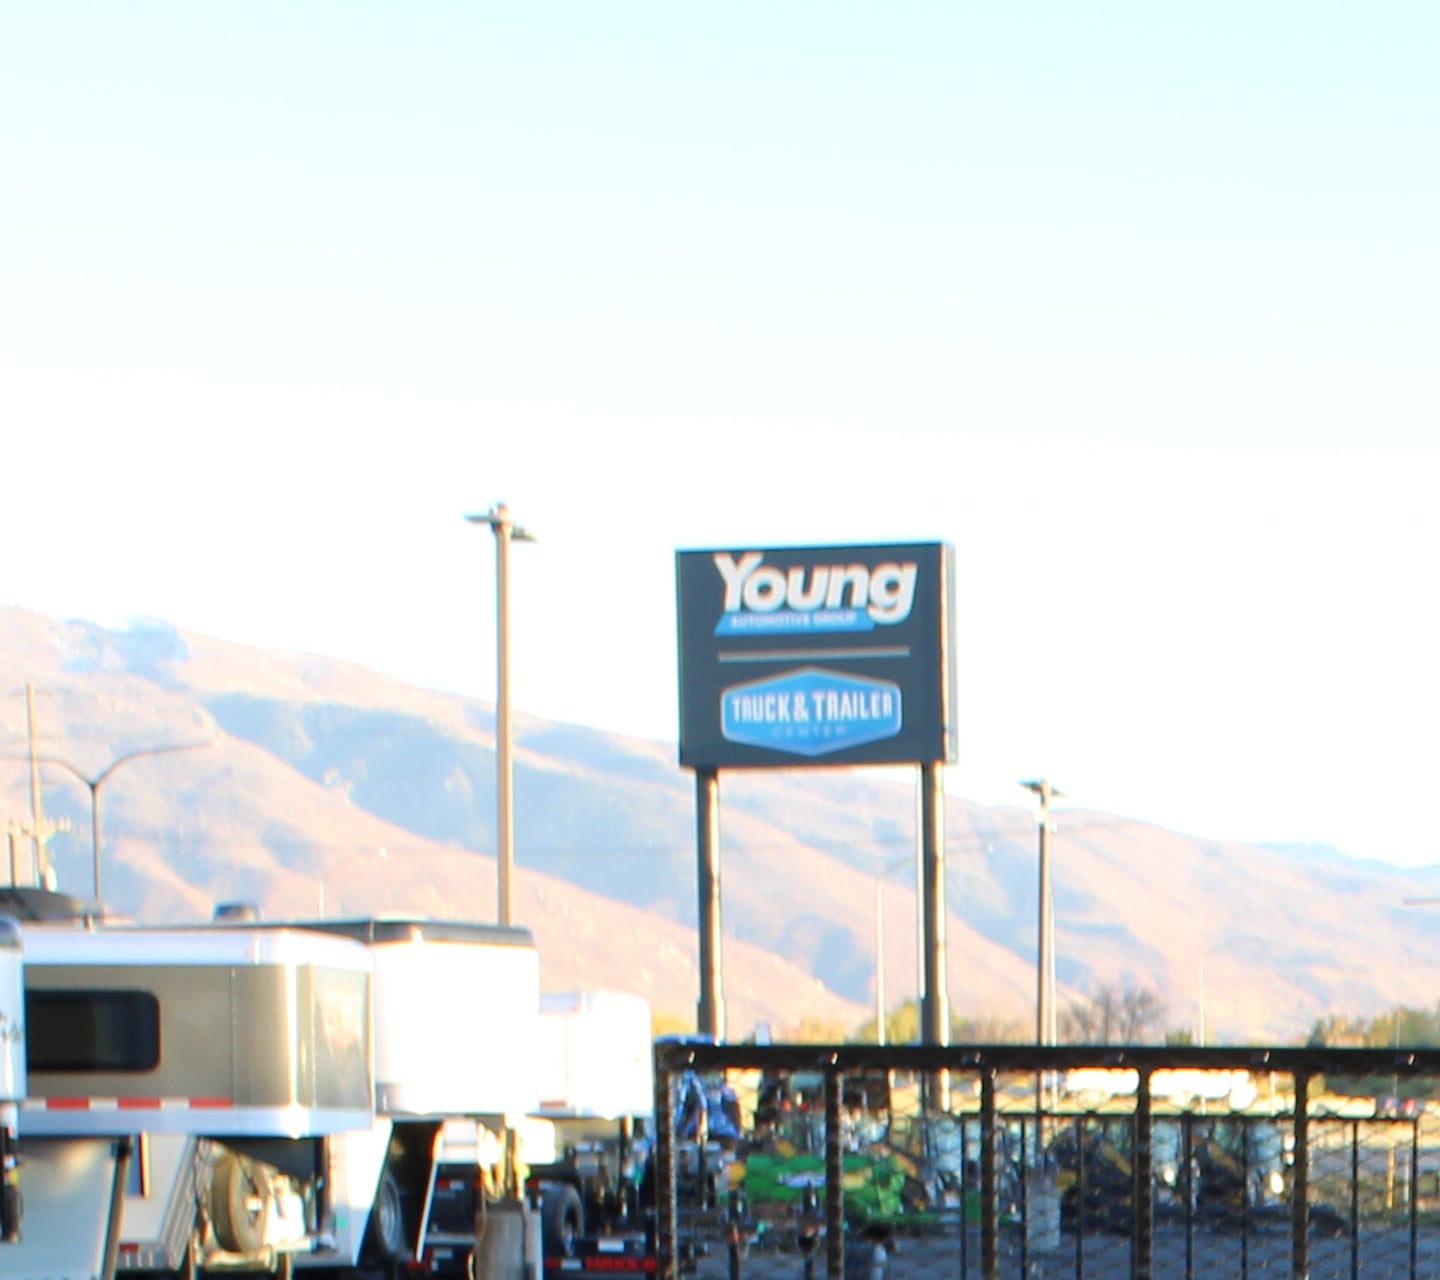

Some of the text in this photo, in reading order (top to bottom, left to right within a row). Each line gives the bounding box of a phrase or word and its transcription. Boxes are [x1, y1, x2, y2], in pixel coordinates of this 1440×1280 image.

[714, 551, 918, 626] Young
[731, 688, 893, 723] TRUCK & TRAILER
